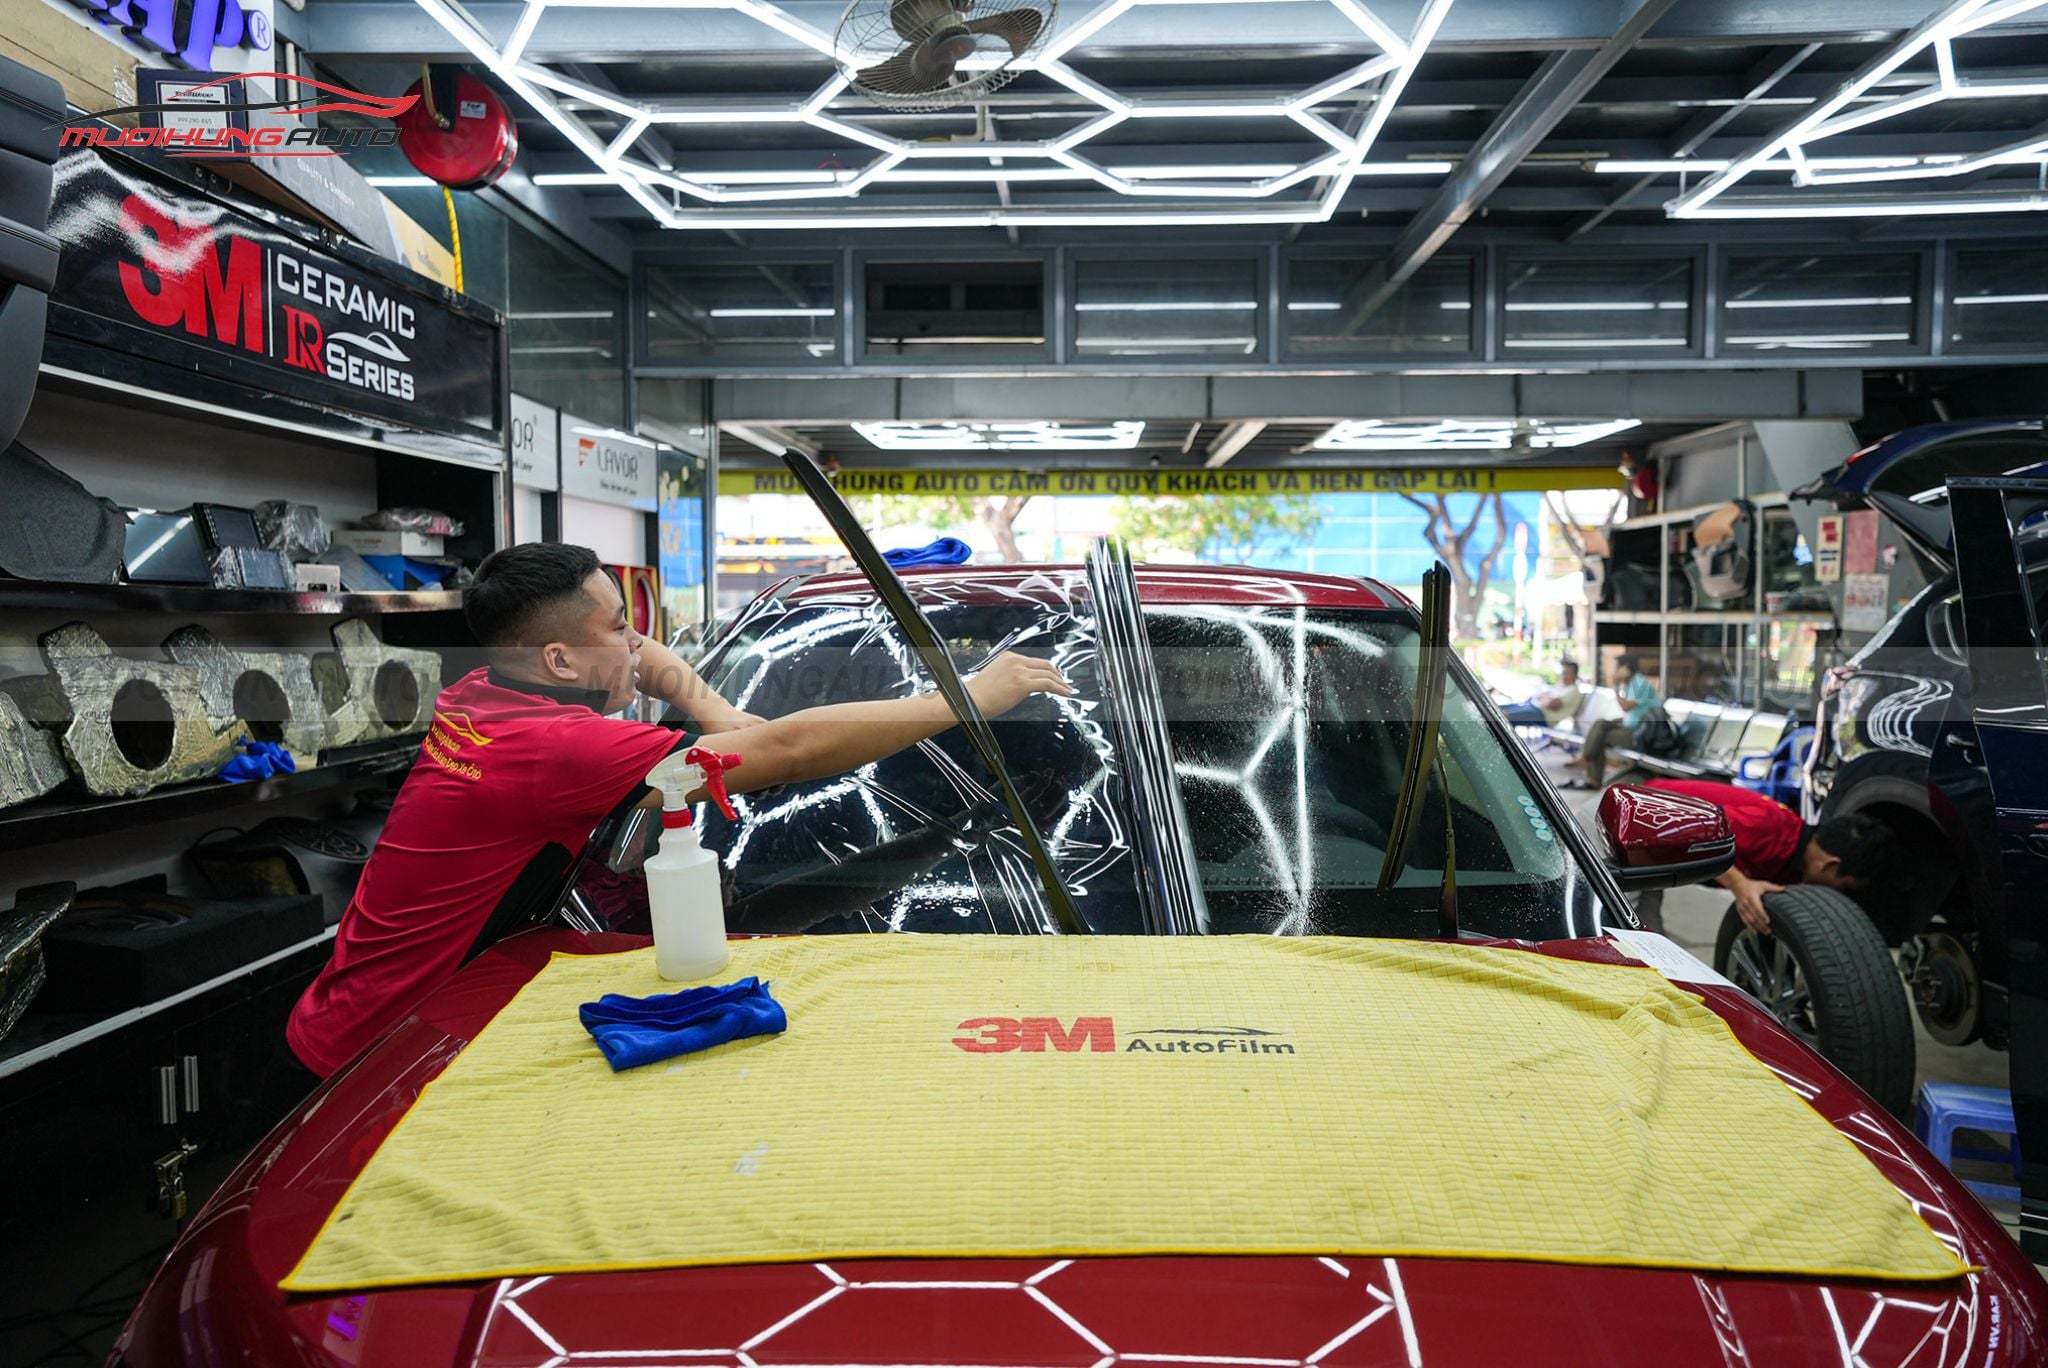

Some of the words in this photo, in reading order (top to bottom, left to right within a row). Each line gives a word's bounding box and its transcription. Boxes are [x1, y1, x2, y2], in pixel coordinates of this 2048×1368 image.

[118, 194, 264, 354] 3M
[276, 252, 416, 340] CERAMIC
[325, 342, 416, 401] SERIES
[597, 445, 638, 480] LAVOR
[914, 473, 979, 491] AUTO
[951, 1016, 1116, 1054] 3M
[1126, 1038, 1295, 1055] AutoFilm
